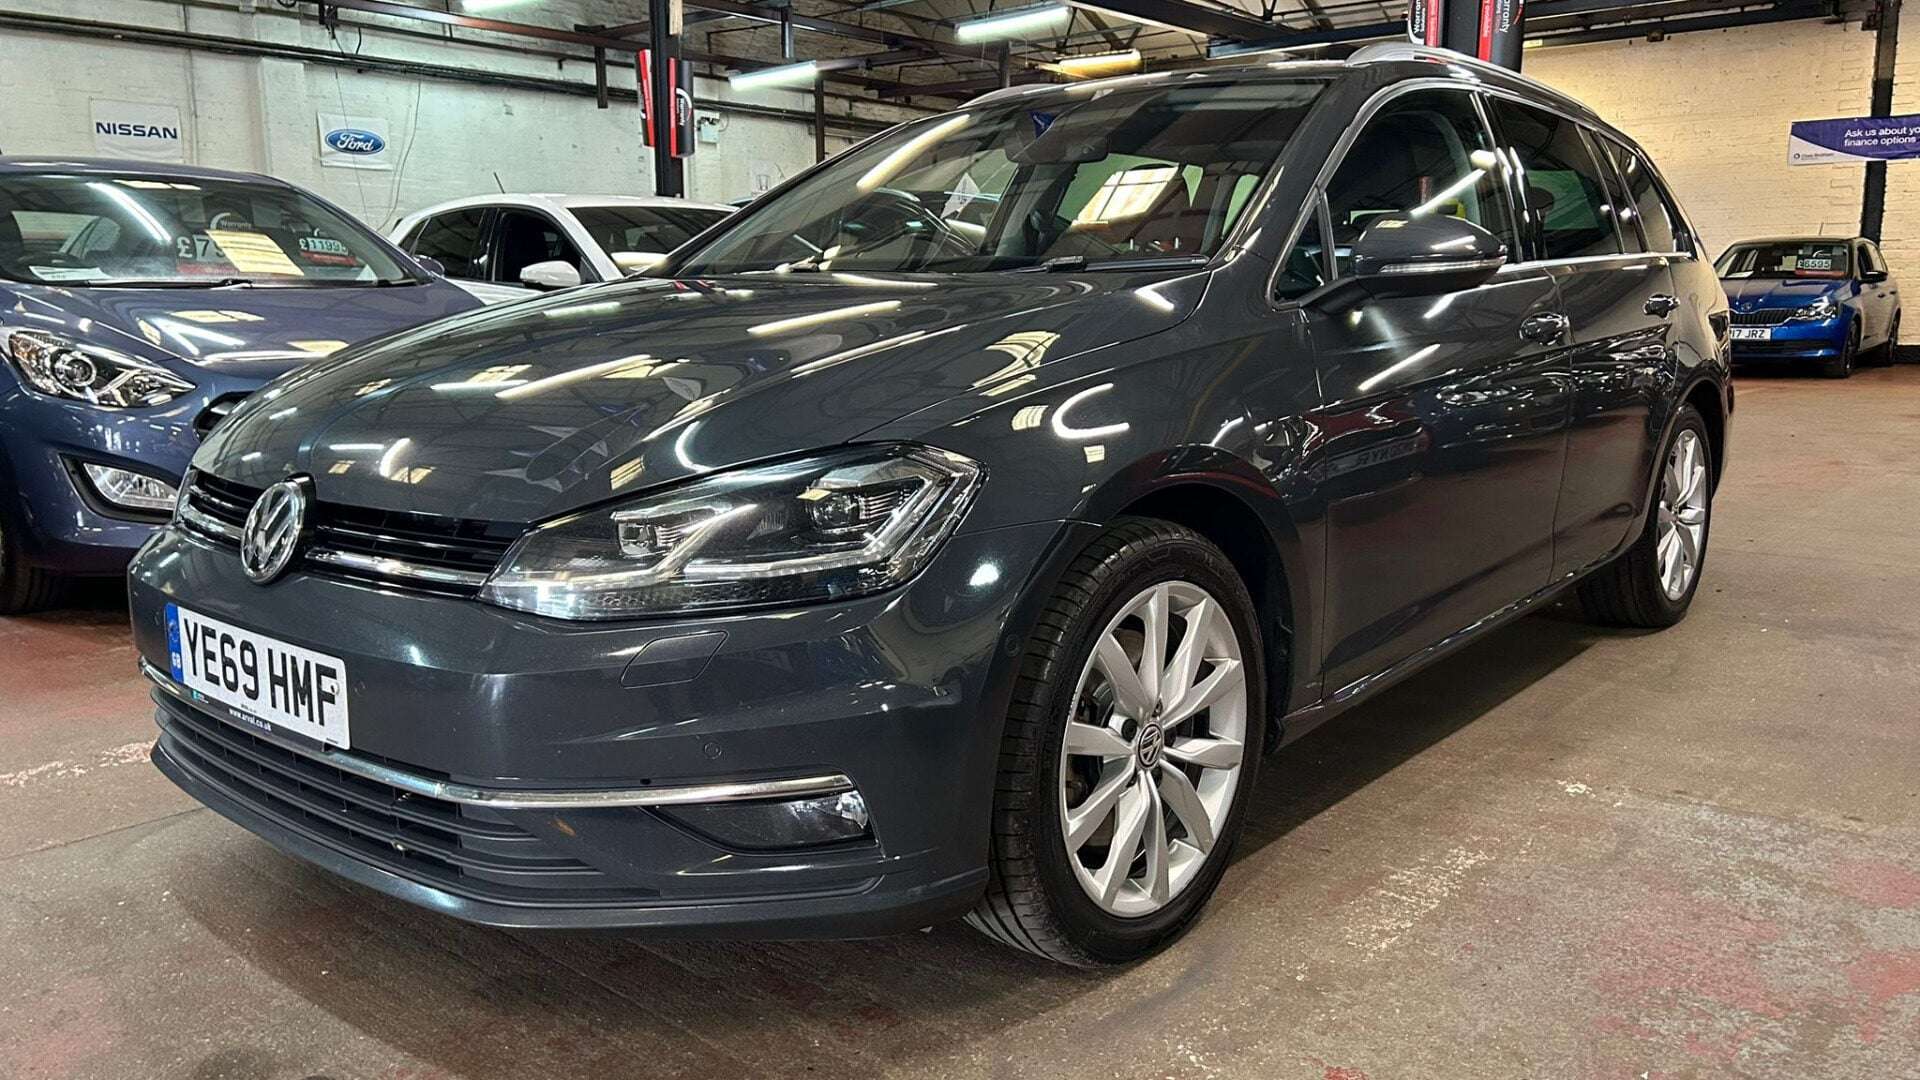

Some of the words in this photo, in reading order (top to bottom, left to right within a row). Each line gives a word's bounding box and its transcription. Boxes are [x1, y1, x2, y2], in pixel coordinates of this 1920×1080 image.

[95, 121, 178, 140] NISSAN
[1844, 129, 1863, 138] Ask
[1865, 128, 1877, 137] us
[1879, 126, 1907, 136] about
[336, 131, 374, 152] Ford
[1844, 138, 1878, 147] finance
[1880, 136, 1916, 146] options
[1745, 329, 1765, 338] JRZ
[171, 651, 182, 669] GB
[183, 618, 260, 701] YE69
[267, 647, 338, 727] HMF
